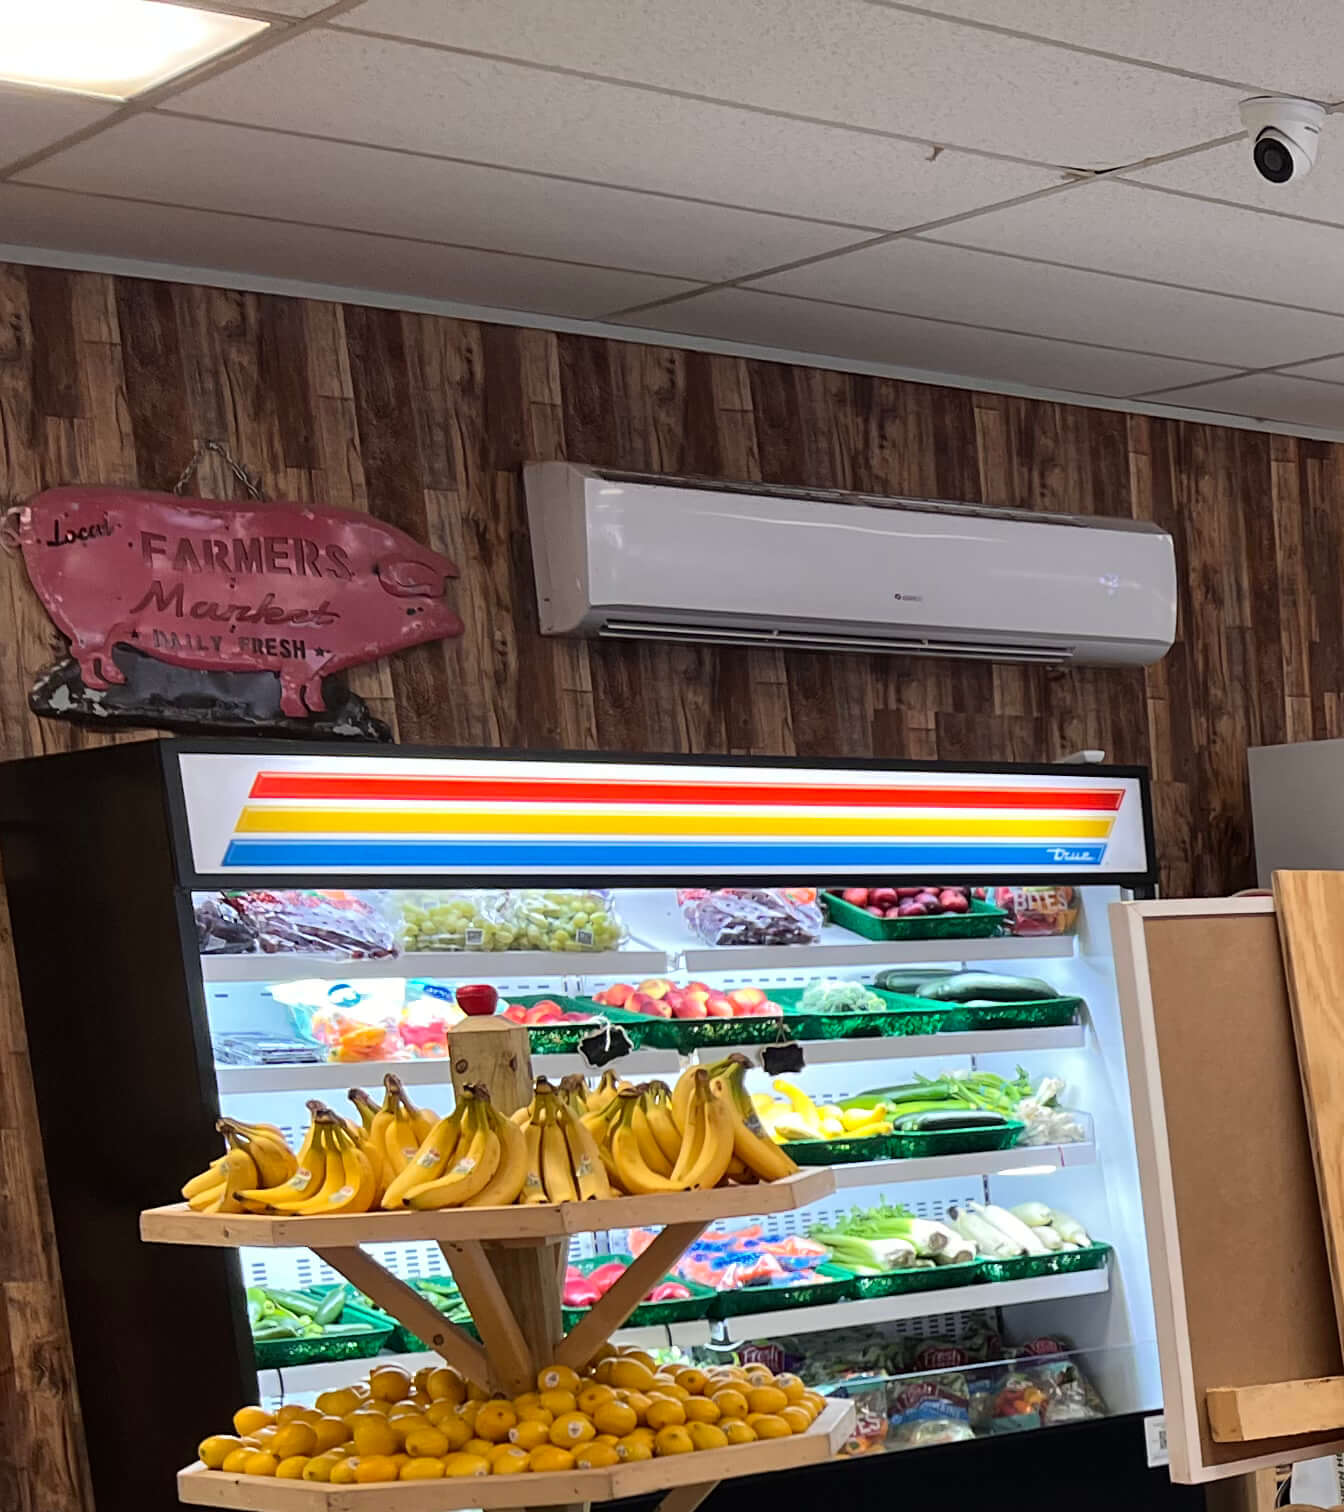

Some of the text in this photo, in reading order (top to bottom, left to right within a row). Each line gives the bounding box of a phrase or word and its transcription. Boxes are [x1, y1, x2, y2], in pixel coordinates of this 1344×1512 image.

[46, 517, 114, 547] Local
[140, 530, 355, 580] FARMERS
[130, 580, 340, 625] Market
[153, 628, 307, 659] DAILY FRESH
[1047, 845, 1096, 863] True
[1012, 887, 1068, 914] BITES
